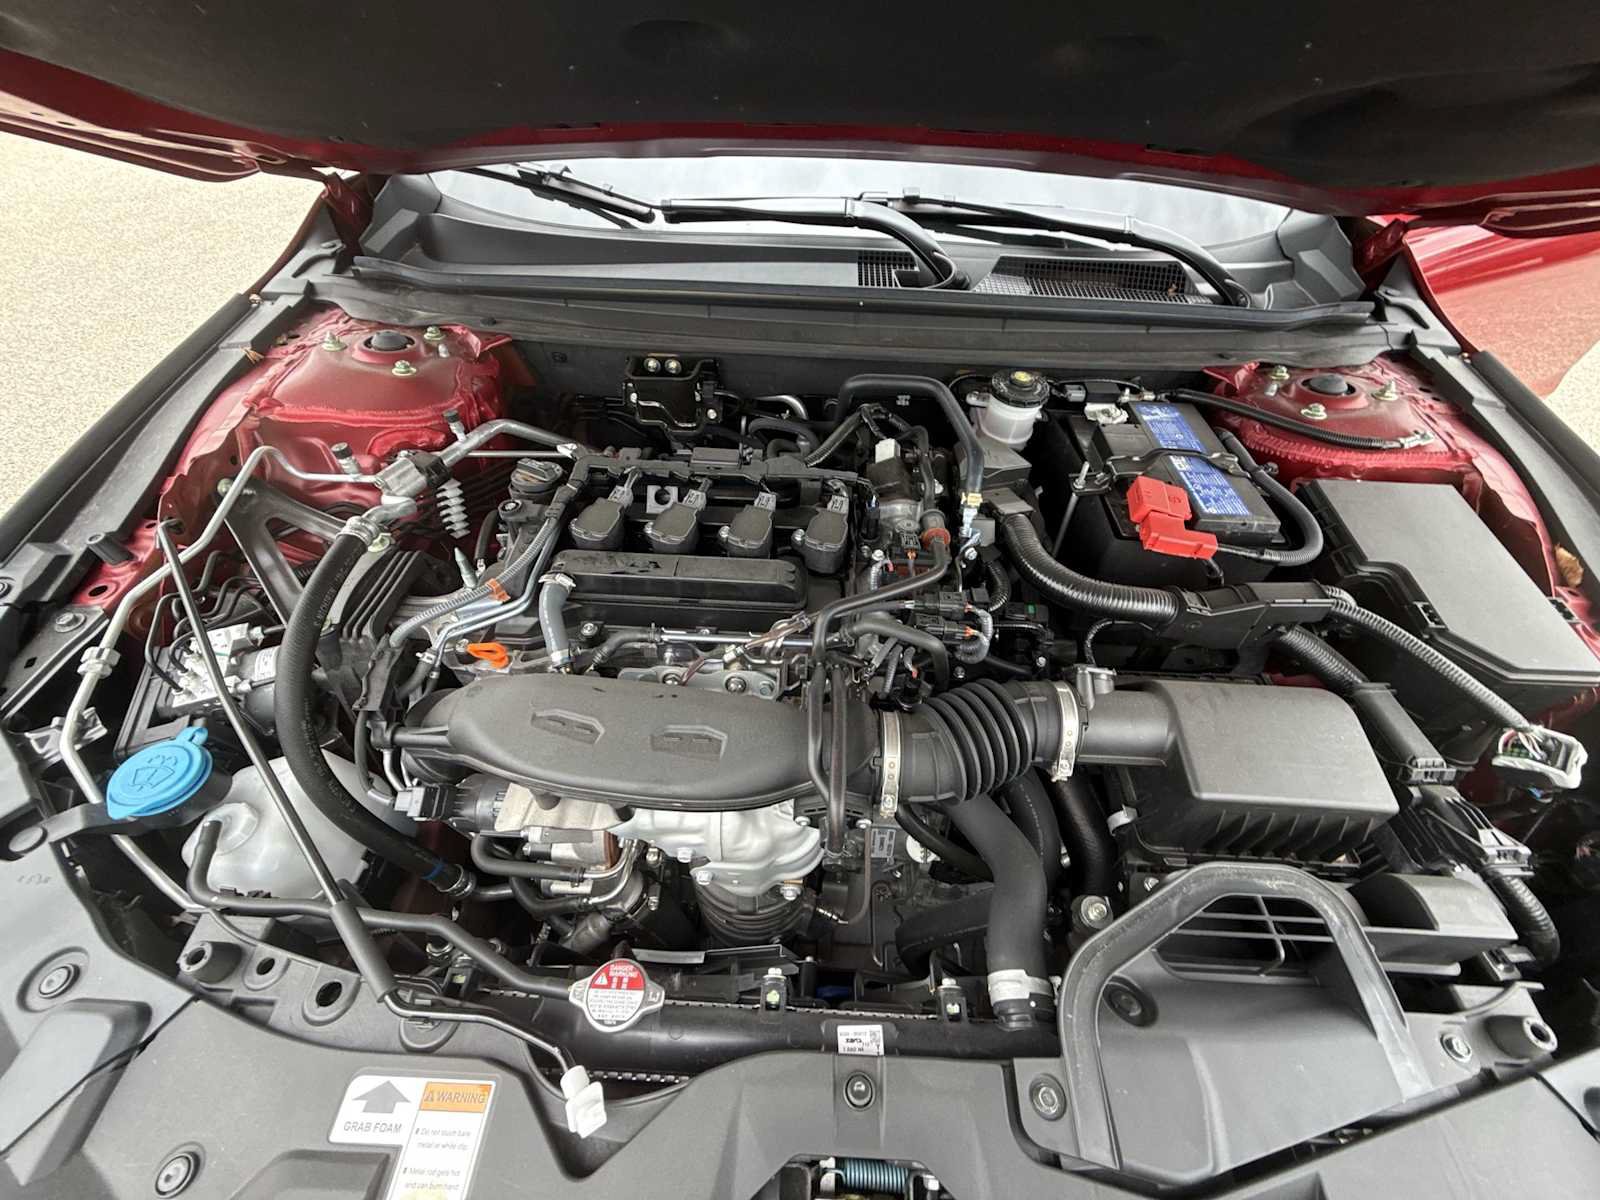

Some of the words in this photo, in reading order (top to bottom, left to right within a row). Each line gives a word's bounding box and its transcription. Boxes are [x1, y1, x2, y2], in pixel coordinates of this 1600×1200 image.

[437, 1090, 486, 1103] WARNING
[343, 1121, 372, 1132] GRAB
[373, 1122, 402, 1134] FOAM
